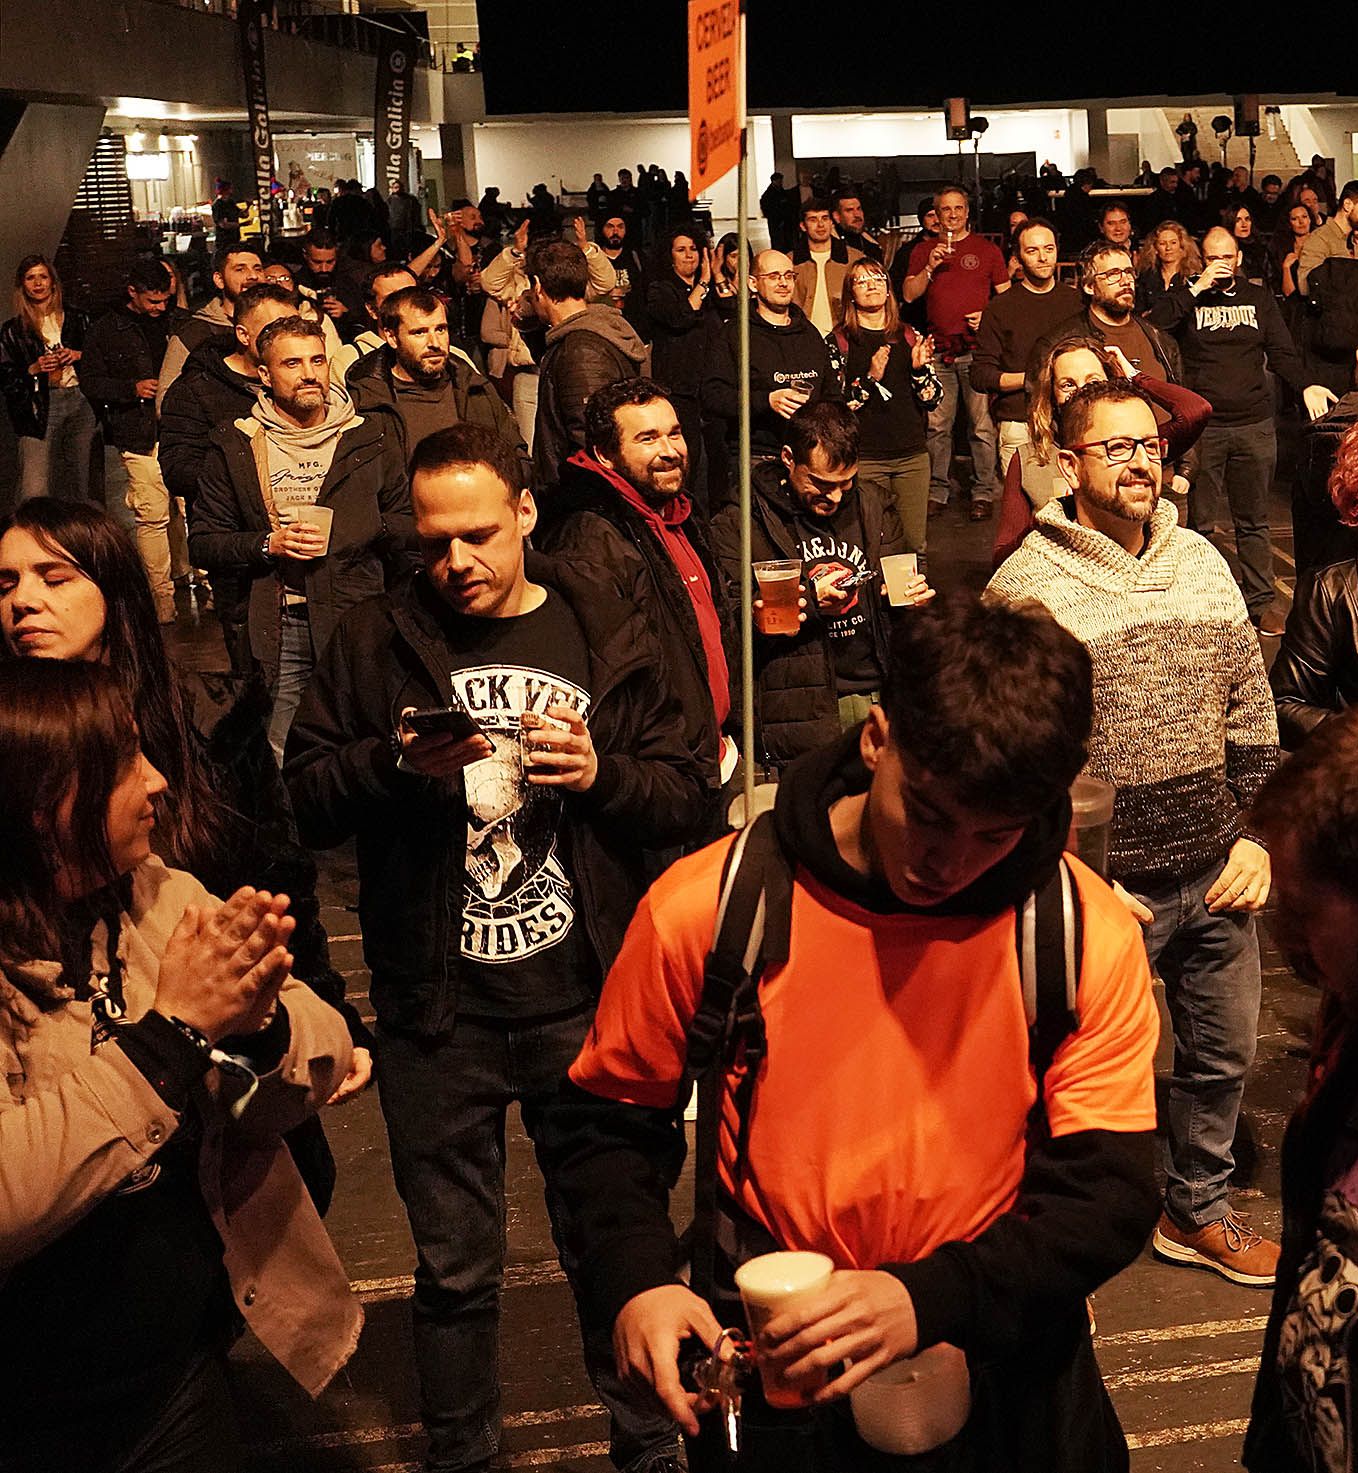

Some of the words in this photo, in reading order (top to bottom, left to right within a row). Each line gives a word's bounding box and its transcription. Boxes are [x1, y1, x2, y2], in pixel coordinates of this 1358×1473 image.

[386, 79, 404, 150] Galicia
[298, 461, 323, 469] MFG.
[851, 615, 866, 625] CO.
[461, 902, 568, 955] RIDES
